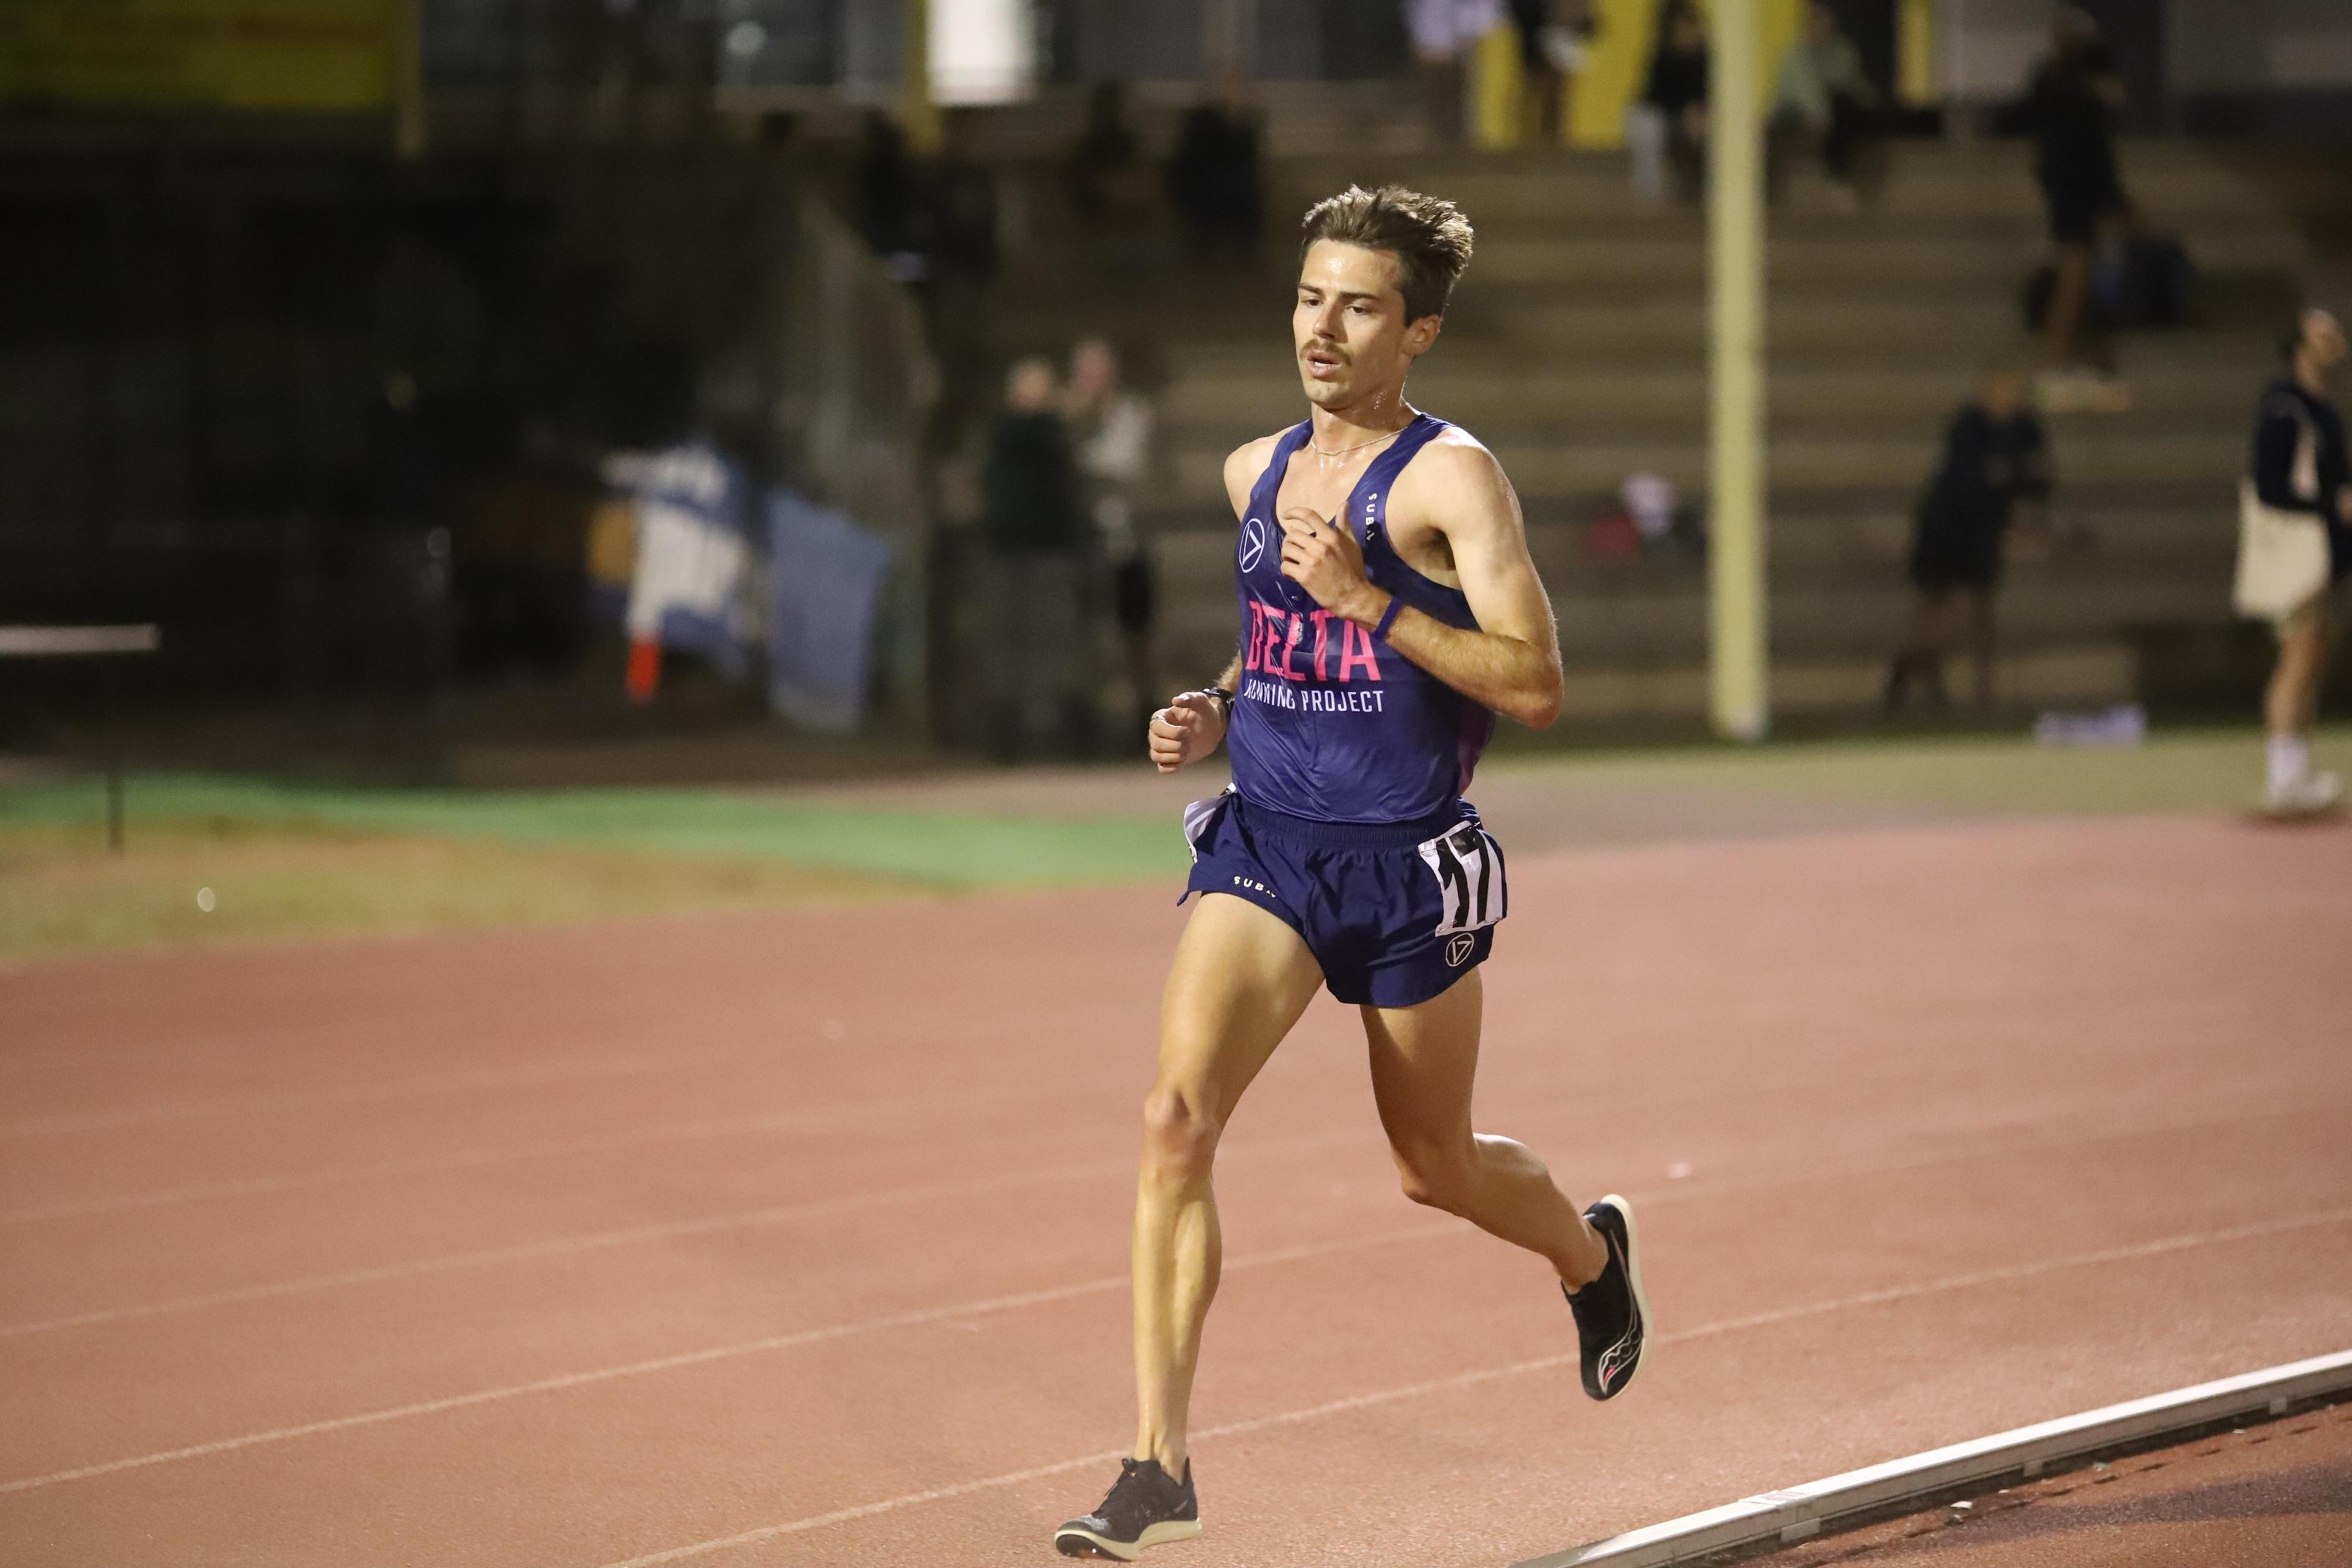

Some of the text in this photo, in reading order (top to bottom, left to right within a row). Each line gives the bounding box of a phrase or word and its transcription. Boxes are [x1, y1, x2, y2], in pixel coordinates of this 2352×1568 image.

[1245, 601, 1382, 682] DELTA
[1302, 690, 1383, 712] PROJECT
[1436, 828, 1490, 928] 17
